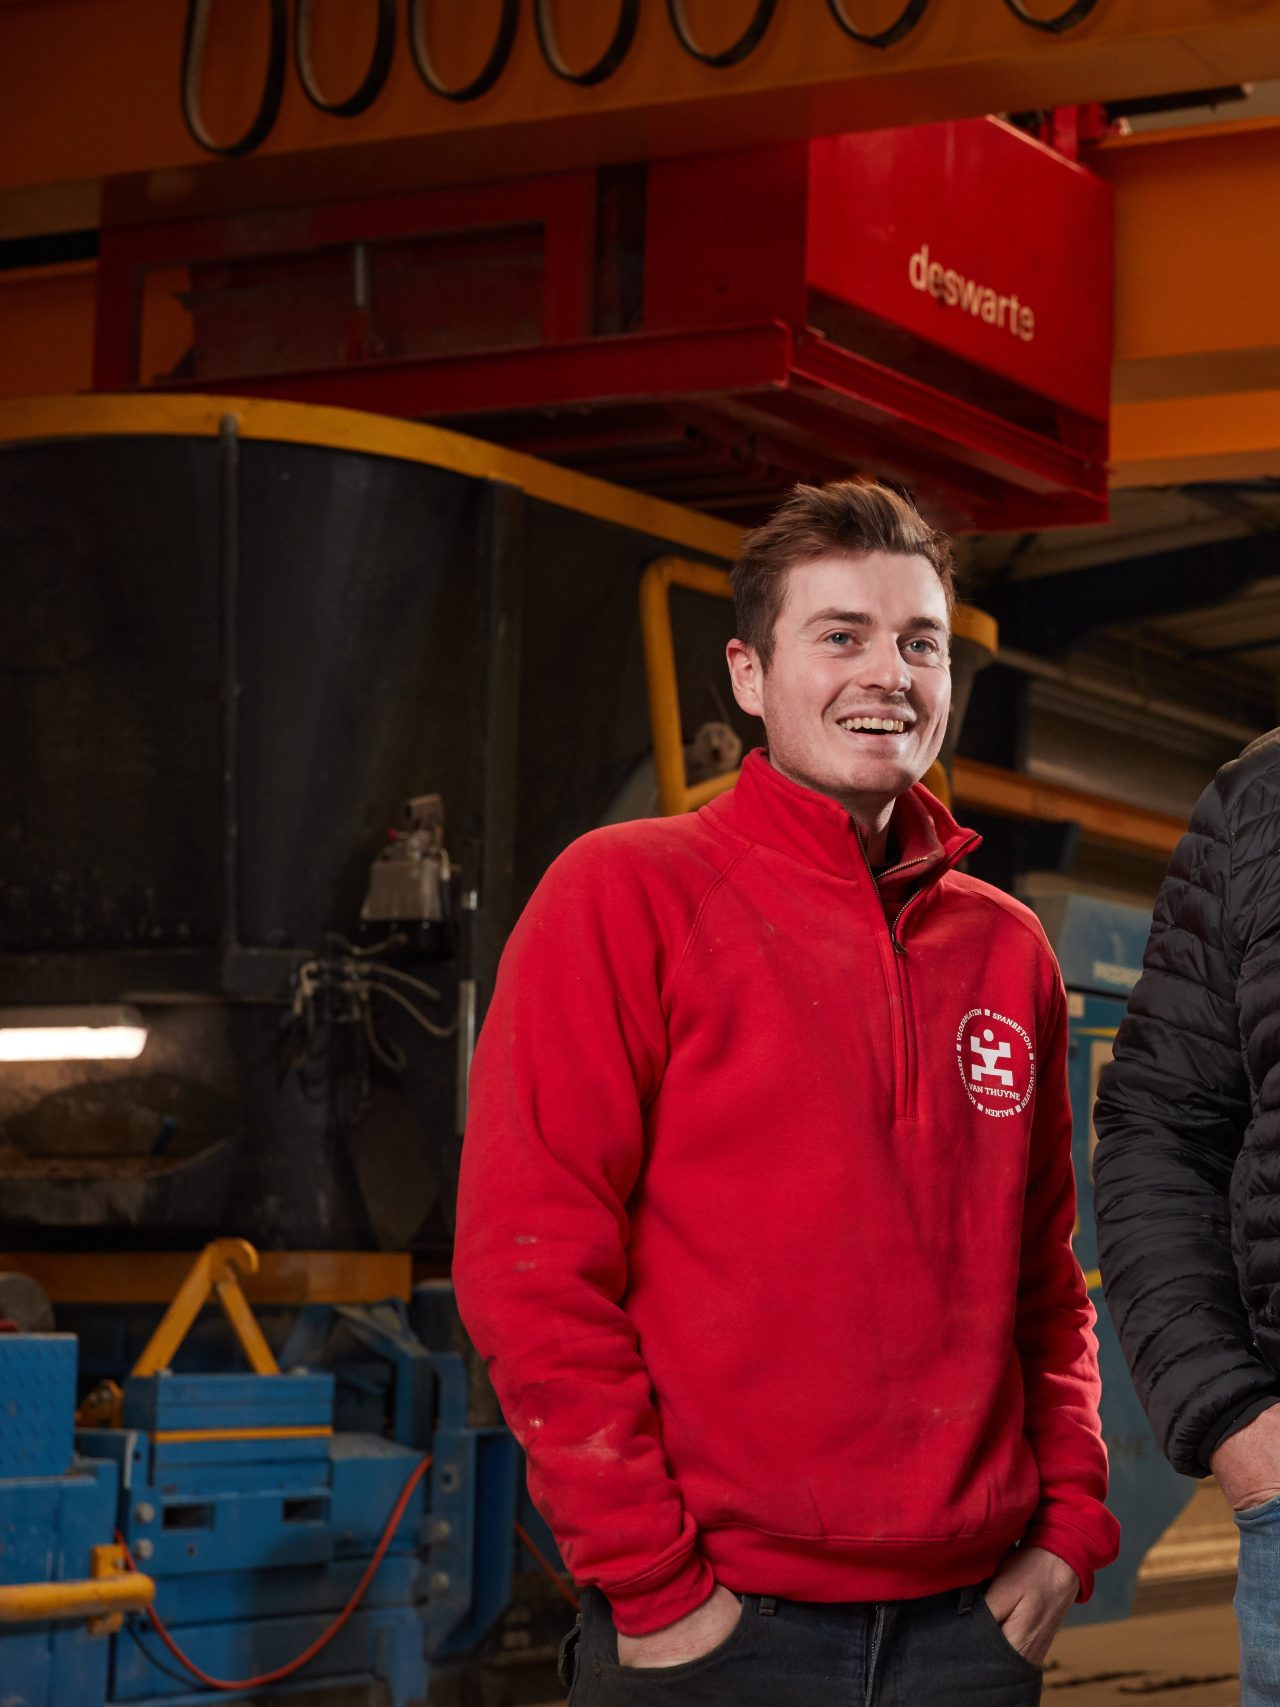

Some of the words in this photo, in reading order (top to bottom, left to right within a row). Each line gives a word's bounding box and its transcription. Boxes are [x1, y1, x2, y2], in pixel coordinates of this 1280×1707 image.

[909, 244, 1035, 342] deswarte
[992, 1012, 1033, 1050] SPANBETON
[968, 1082, 983, 1094] VAN
[984, 1087, 1021, 1101] THUYNE
[985, 1107, 1015, 1118] BALKEN
